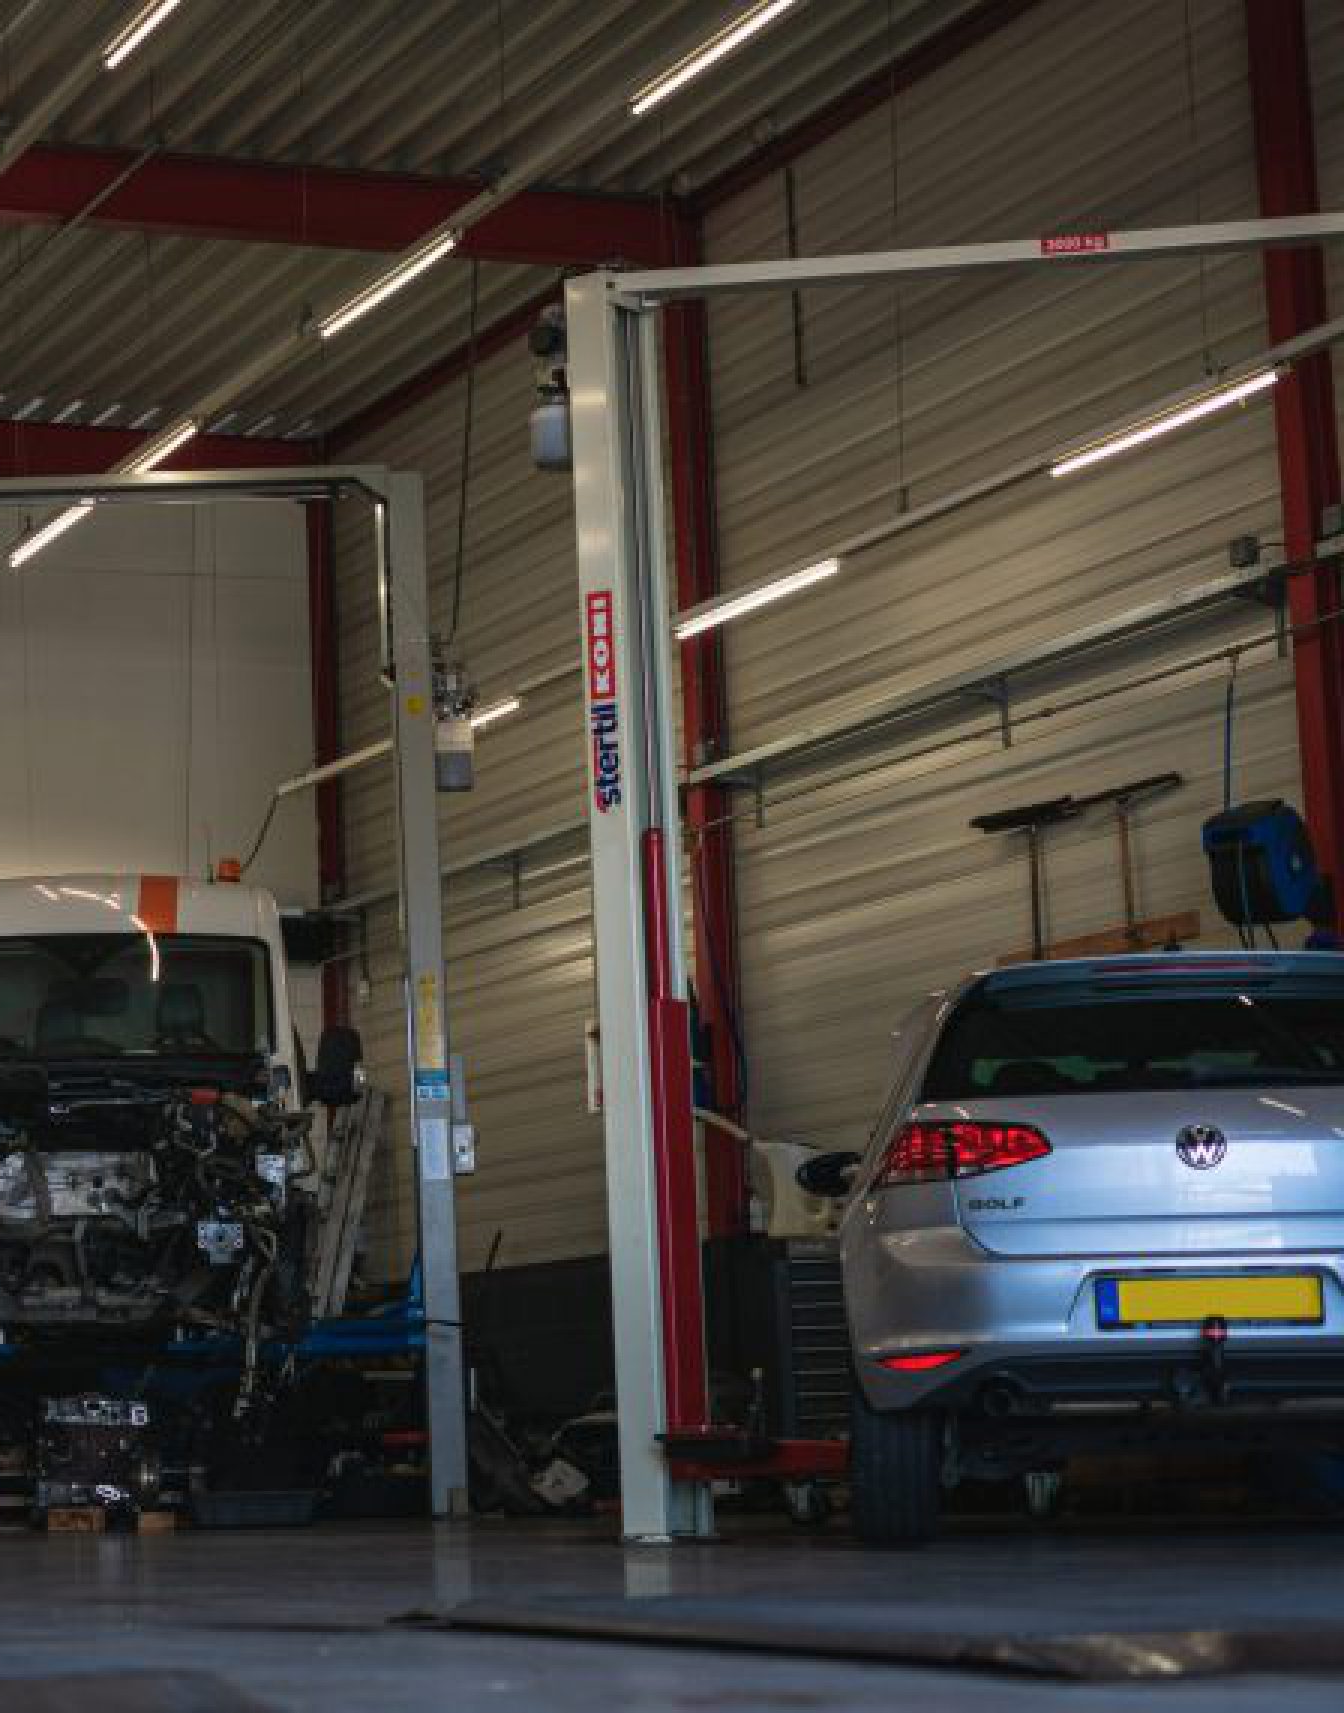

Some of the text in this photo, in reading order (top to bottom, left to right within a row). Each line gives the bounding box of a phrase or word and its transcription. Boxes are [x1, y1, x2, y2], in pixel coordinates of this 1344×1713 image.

[590, 595, 621, 808] stertil KONI
[969, 1197, 1026, 1210] GOLF
